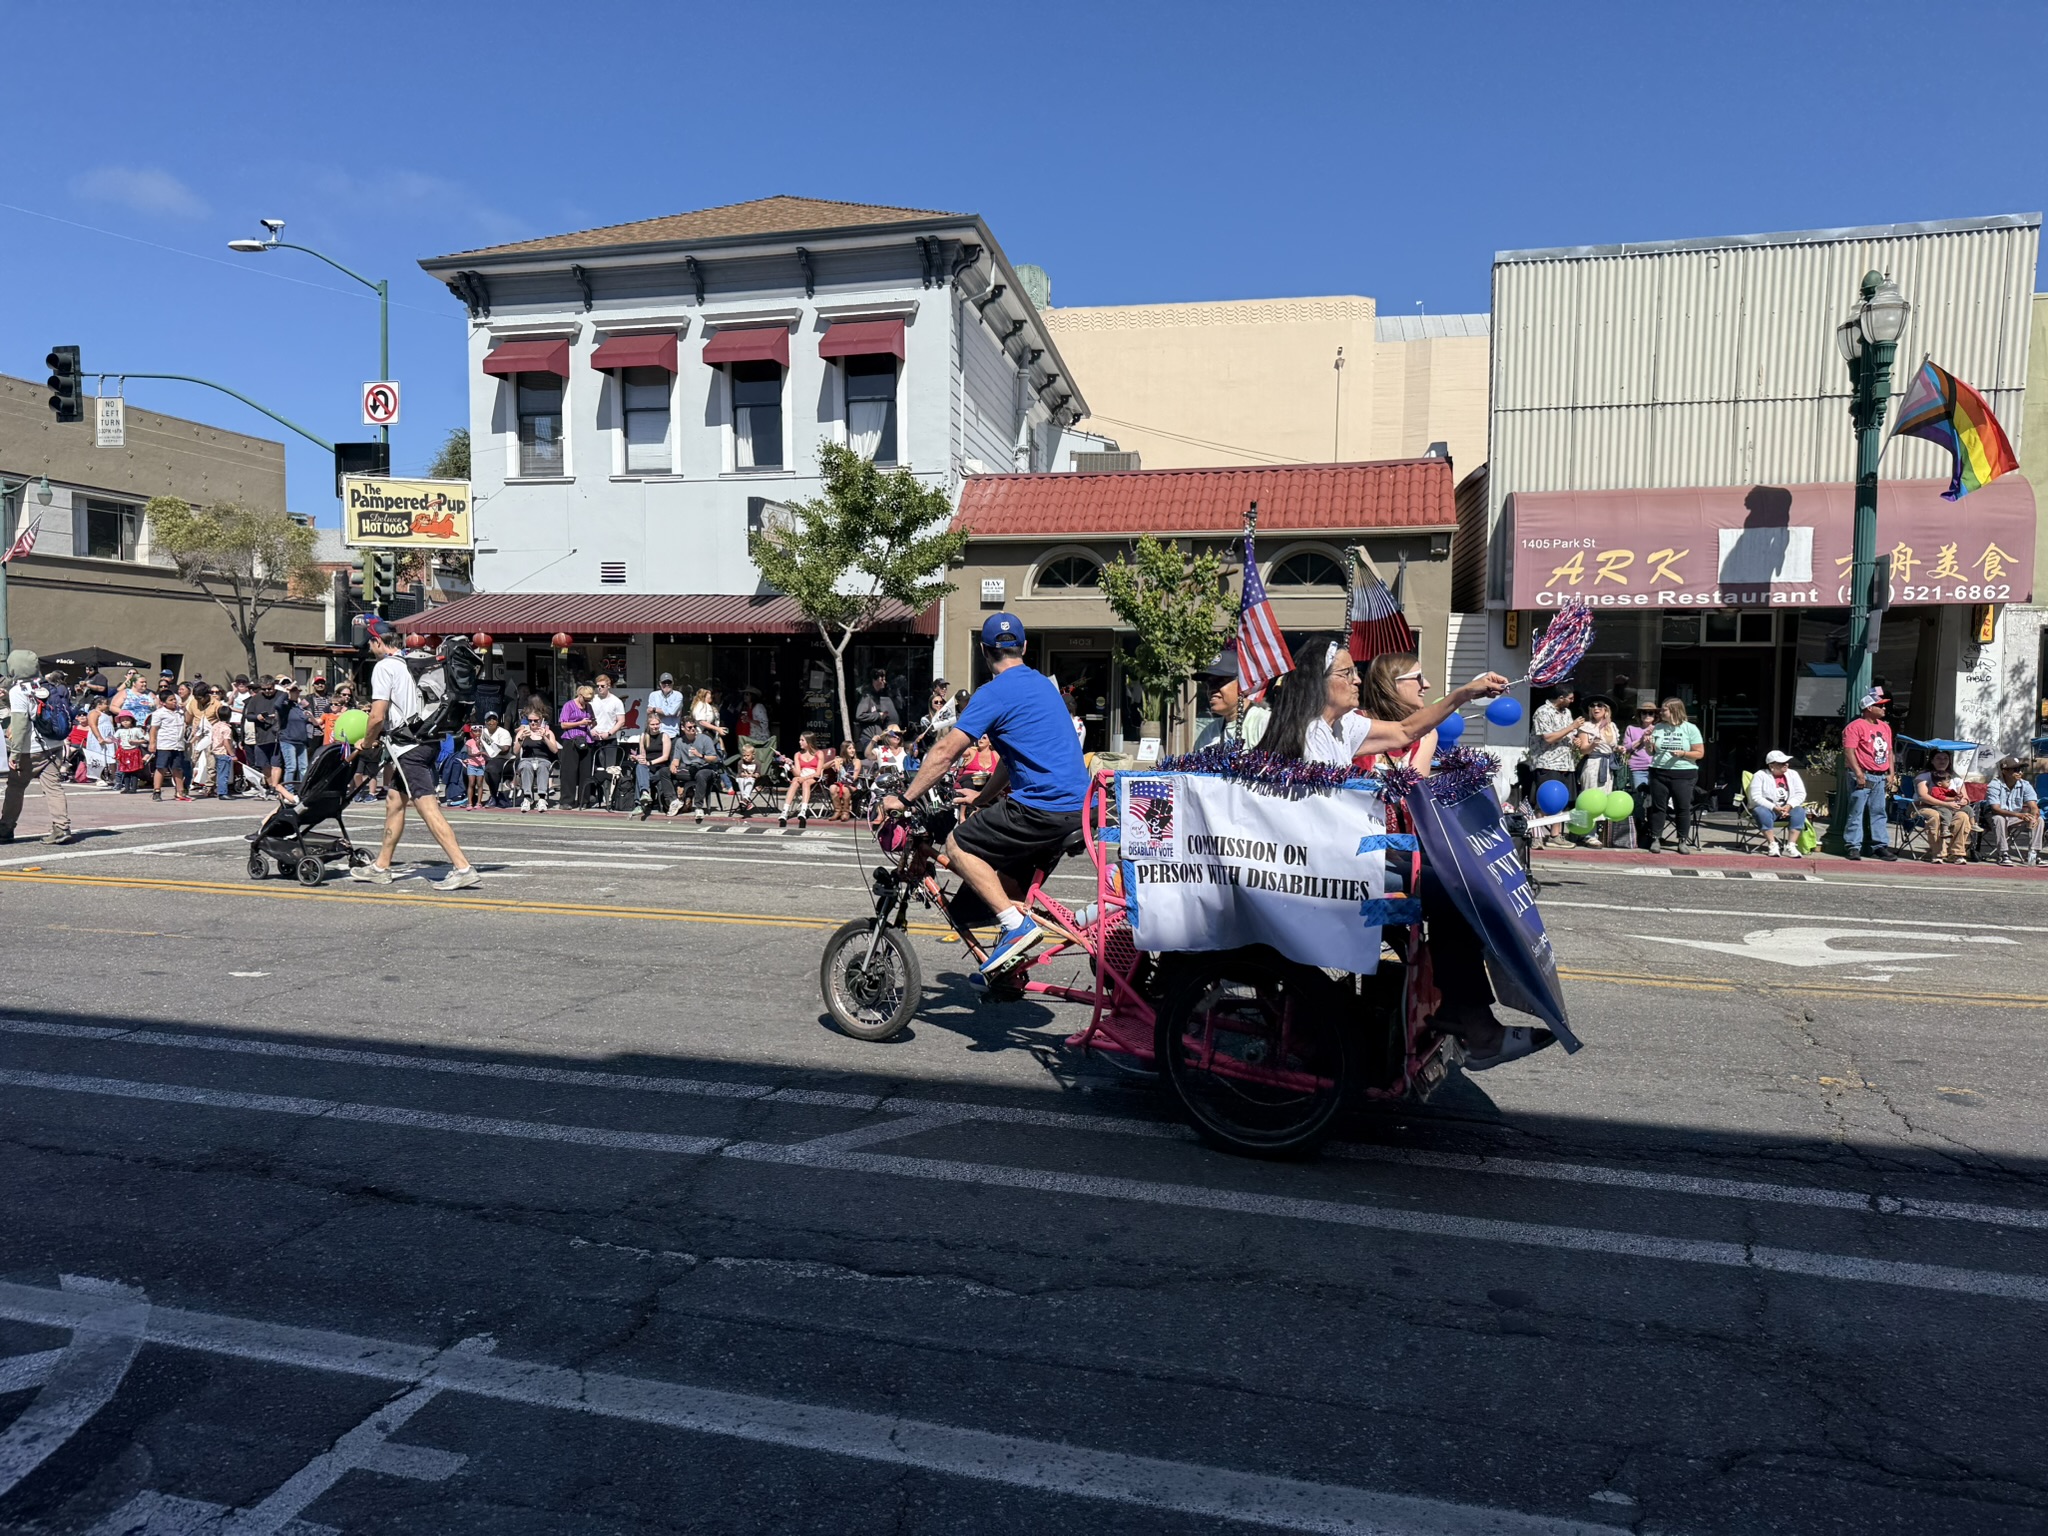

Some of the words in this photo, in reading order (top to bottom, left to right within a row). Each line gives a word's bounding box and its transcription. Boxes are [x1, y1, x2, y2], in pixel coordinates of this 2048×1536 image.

[105, 400, 115, 408] NO
[363, 483, 381, 495] The
[350, 488, 429, 511] Pampered
[437, 492, 466, 514] Pup
[369, 512, 403, 523] Deluxe
[362, 518, 382, 534] HOT
[383, 519, 409, 535] DOGS
[1521, 538, 1550, 549] 1405
[1553, 538, 1580, 549] Park
[1582, 537, 1596, 549] St
[1545, 548, 1690, 588] ARK
[1535, 591, 1649, 606] Chinese
[1658, 590, 1819, 605] Restaurant
[1902, 584, 2011, 601] 521-6862
[1069, 638, 1092, 646] 1403
[1128, 846, 1158, 856] DISABILITY
[1159, 847, 1174, 857] VOTE
[1187, 834, 1278, 864] COMMISSION
[1283, 844, 1308, 867] ON
[1137, 862, 1203, 884] PERSONS
[1207, 863, 1240, 886] WITH
[1246, 868, 1370, 901] DISABILITIES
